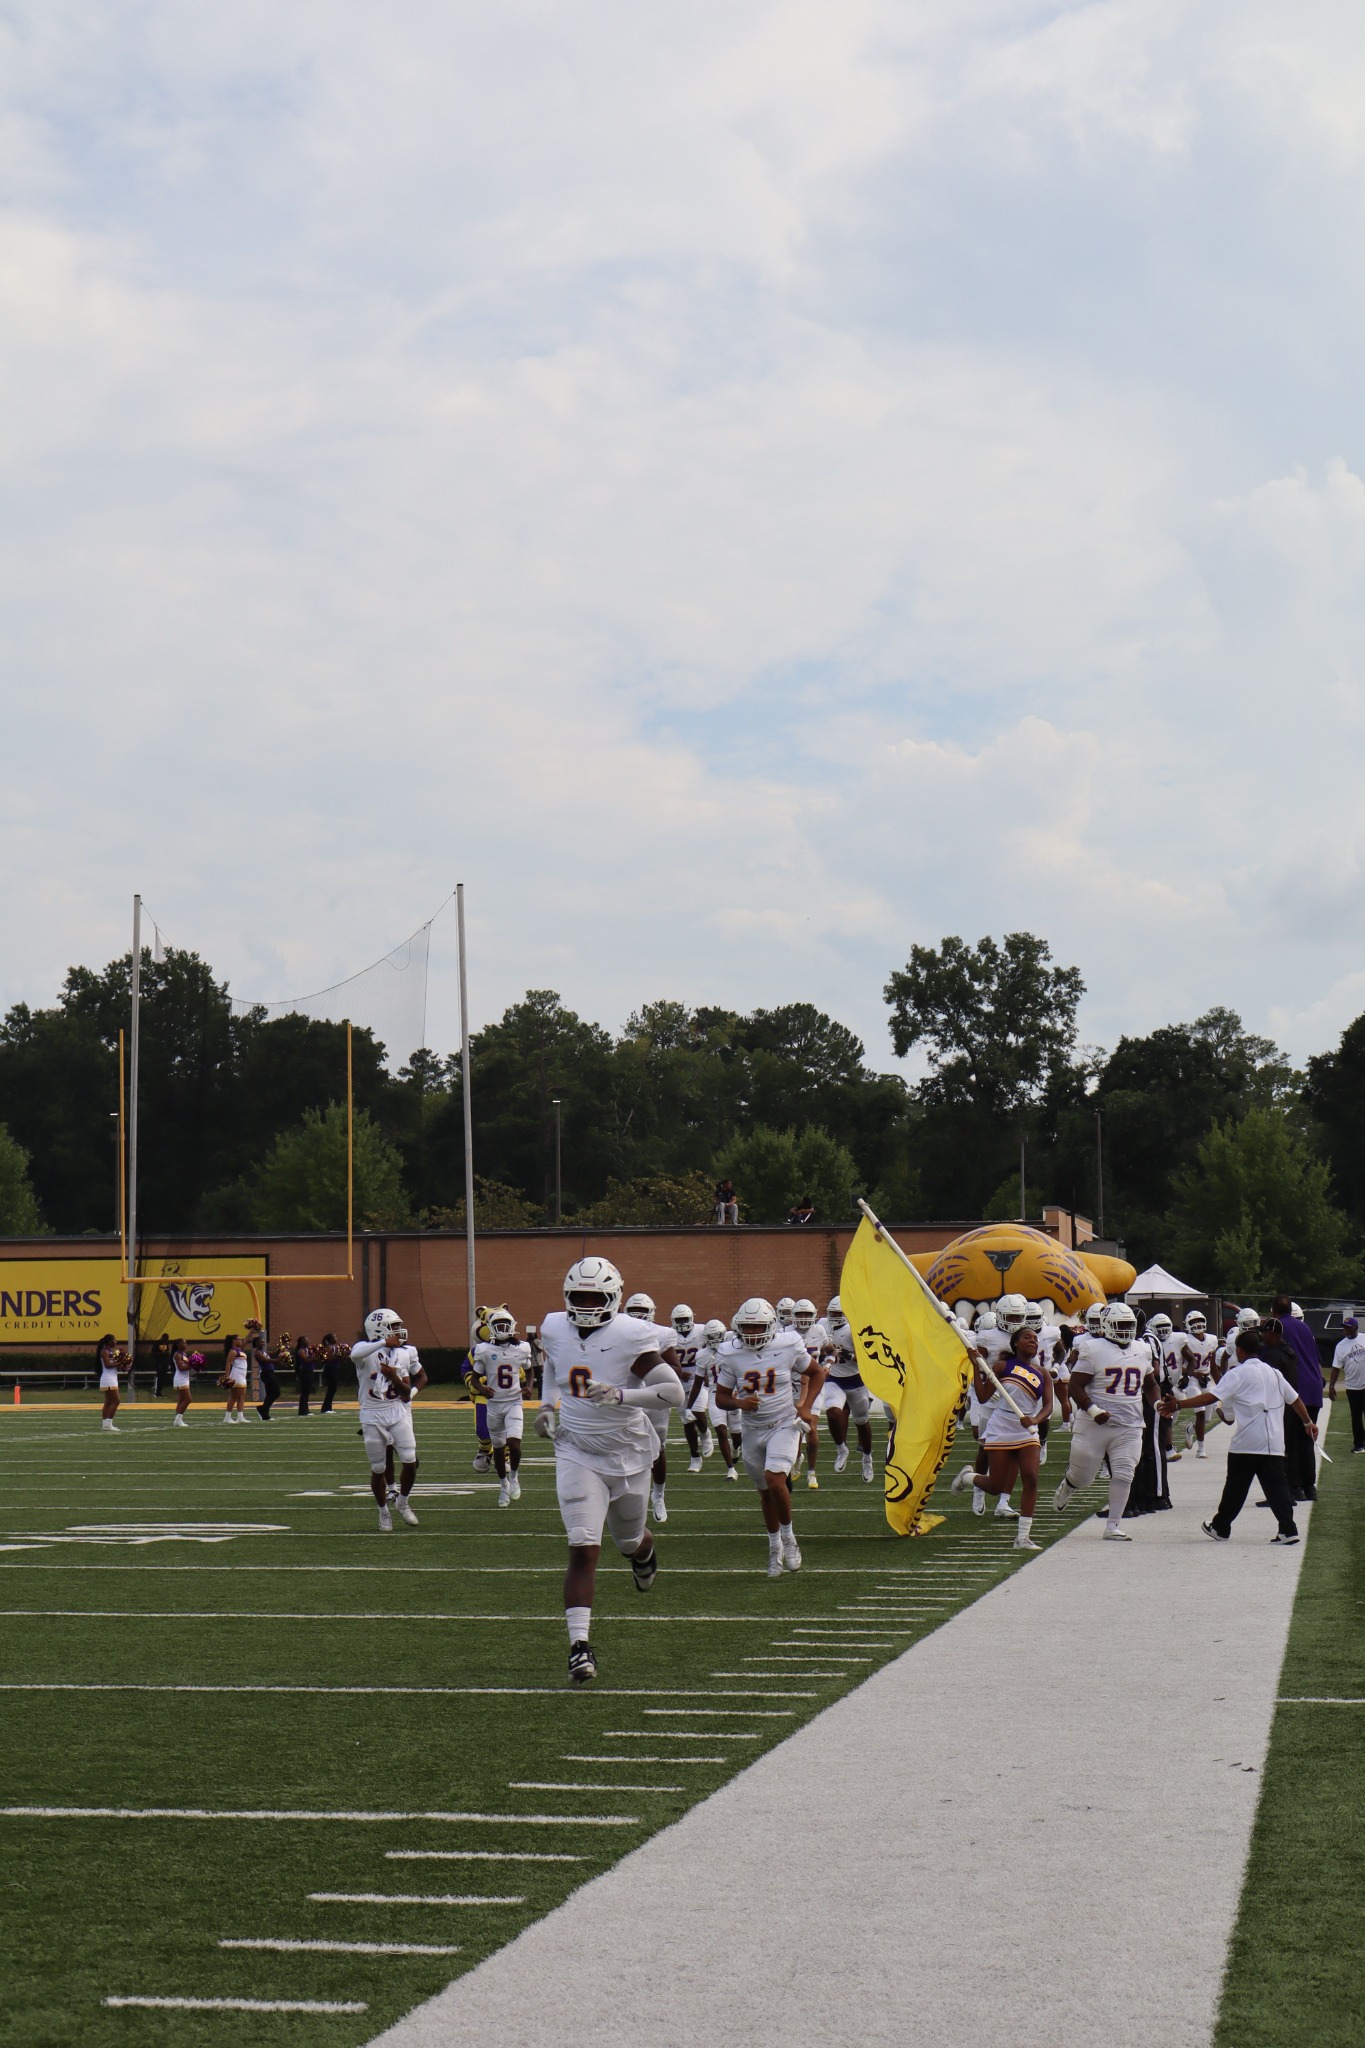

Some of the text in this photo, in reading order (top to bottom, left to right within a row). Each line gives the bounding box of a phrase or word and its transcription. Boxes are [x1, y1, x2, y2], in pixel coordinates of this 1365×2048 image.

[1, 1290, 102, 1317] NDERS
[5, 1320, 100, 1329] CREDIT UNION
[371, 1313, 383, 1322] 36
[497, 1364, 513, 1390] 6
[569, 1366, 591, 1398] 0
[743, 1367, 776, 1394] 31
[1011, 1365, 1041, 1388] BC
[1105, 1367, 1141, 1396] 70
